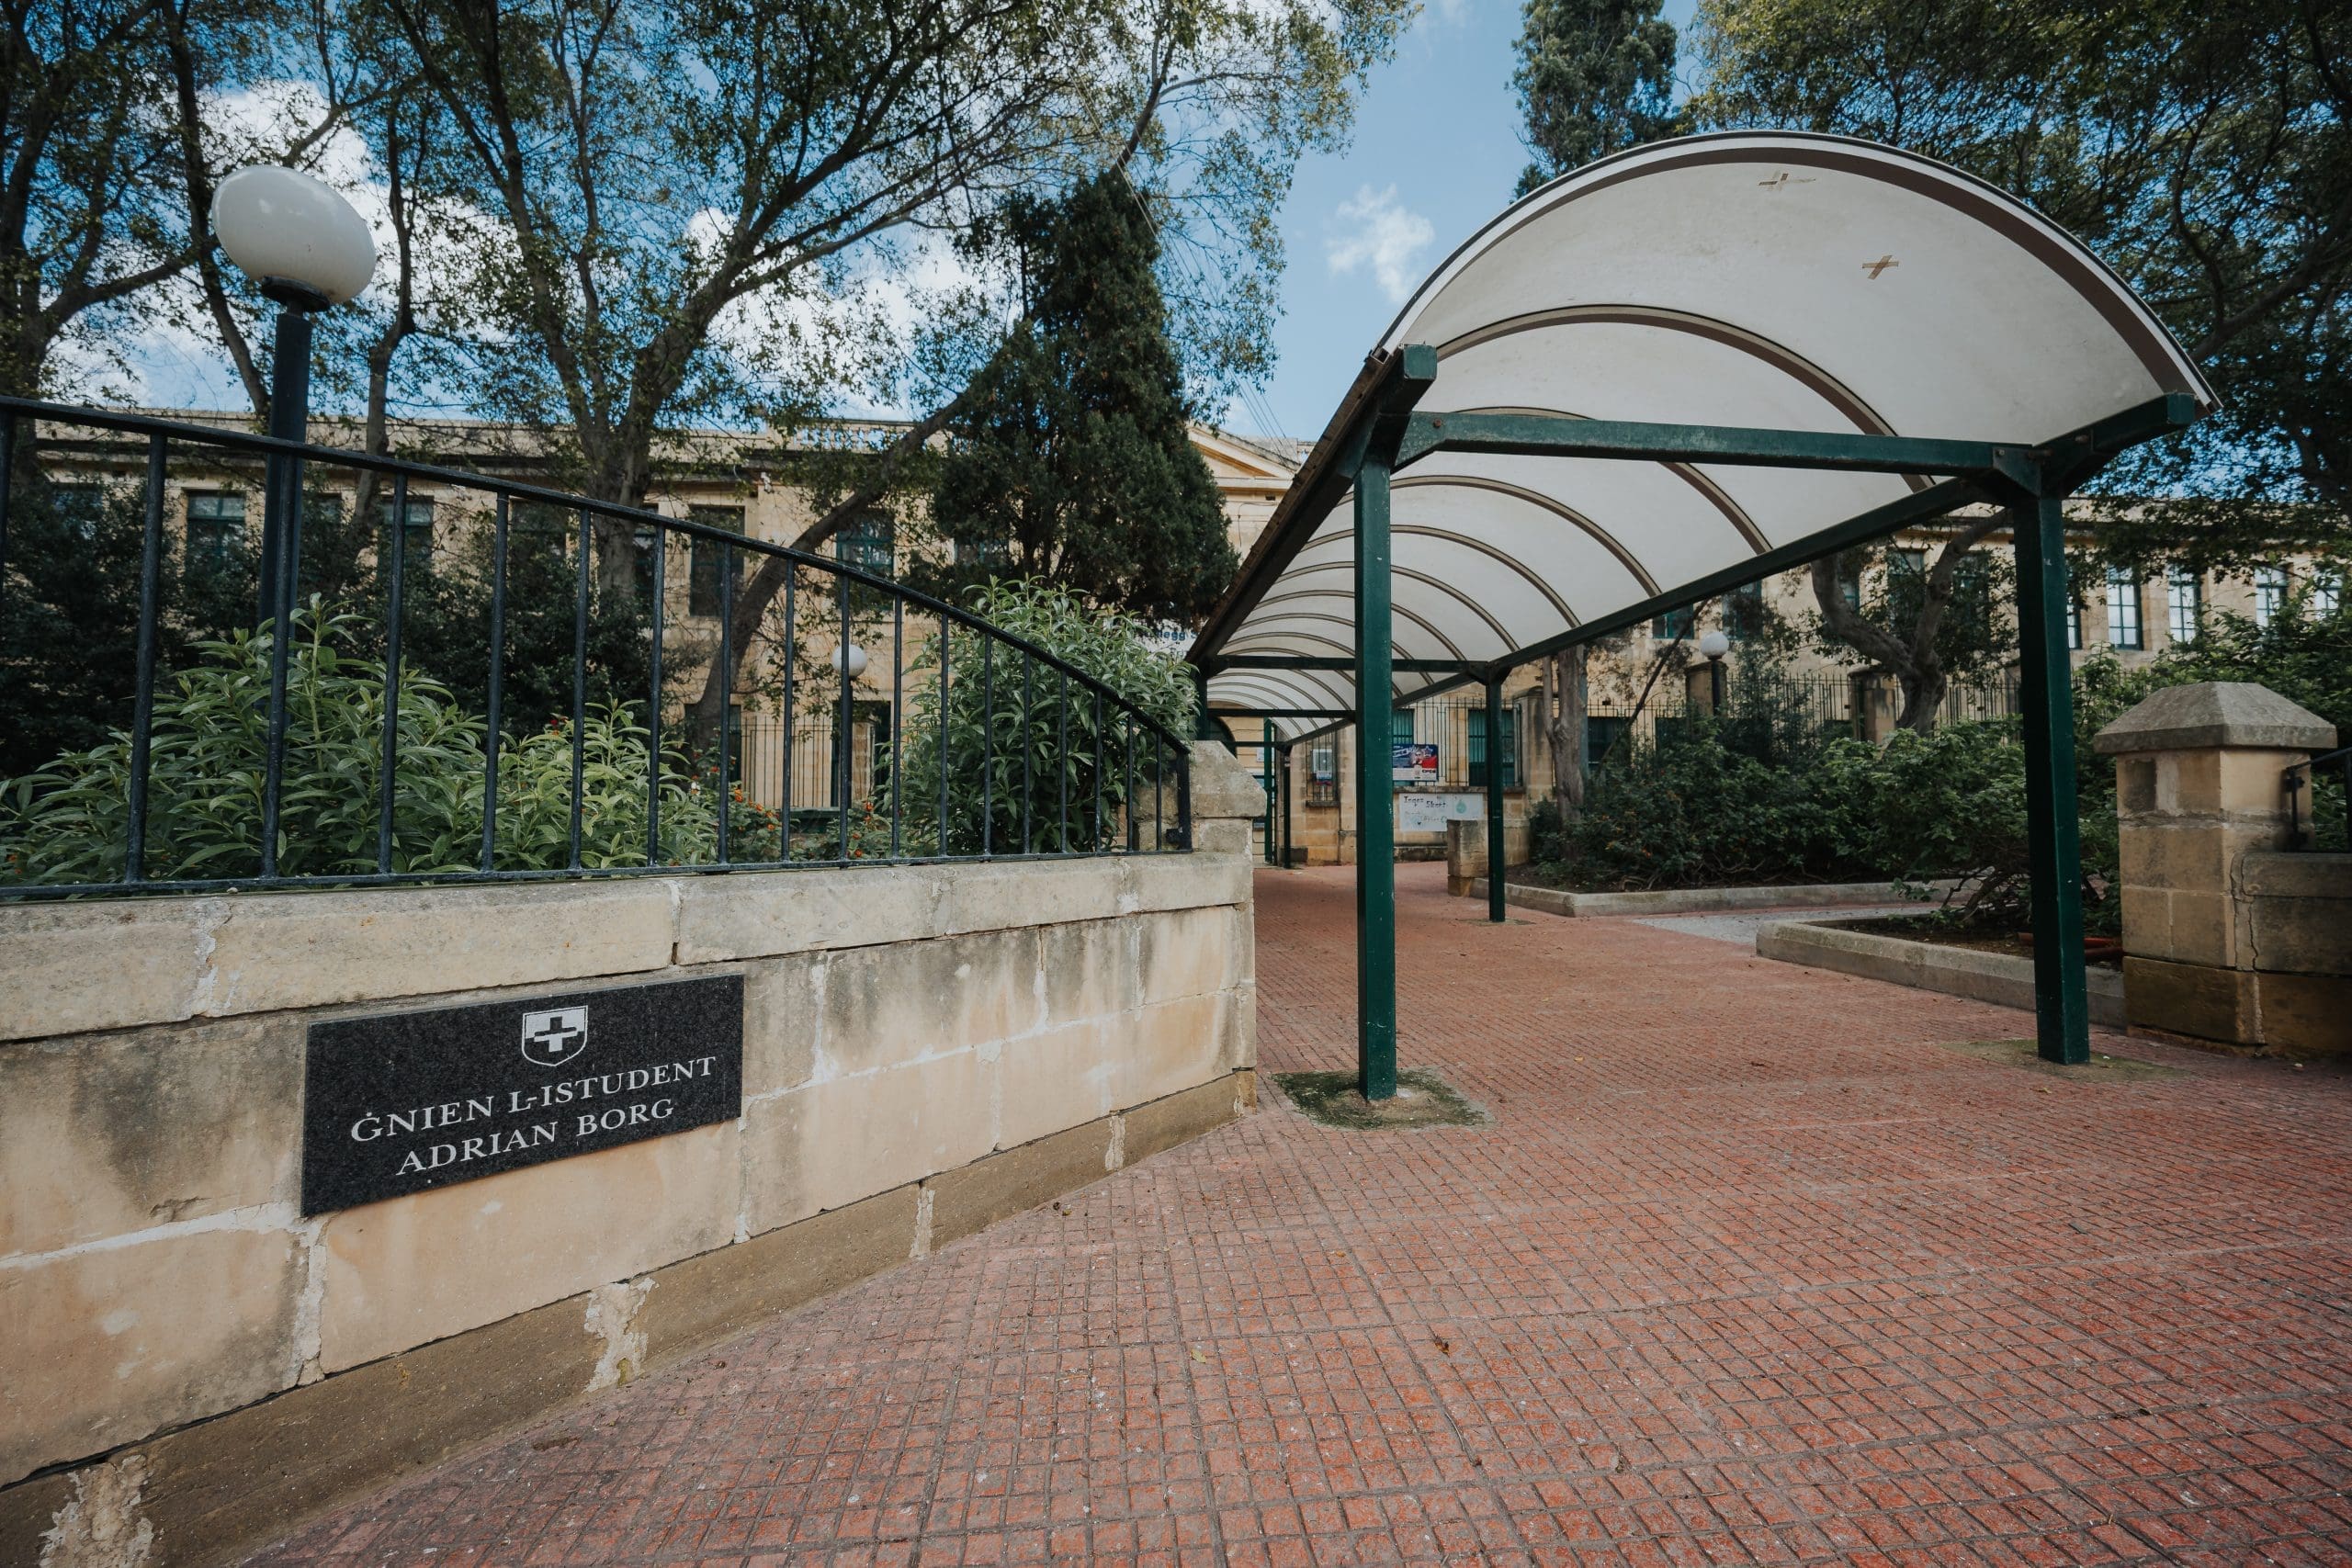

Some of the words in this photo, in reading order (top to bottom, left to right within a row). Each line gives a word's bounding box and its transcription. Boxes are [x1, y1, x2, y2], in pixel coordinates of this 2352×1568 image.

[351, 1096, 493, 1143] ĠNIEN
[509, 1055, 717, 1113] L-ISTUDENT
[395, 1122, 558, 1176] ADRIAN
[576, 1100, 674, 1137] BORG
